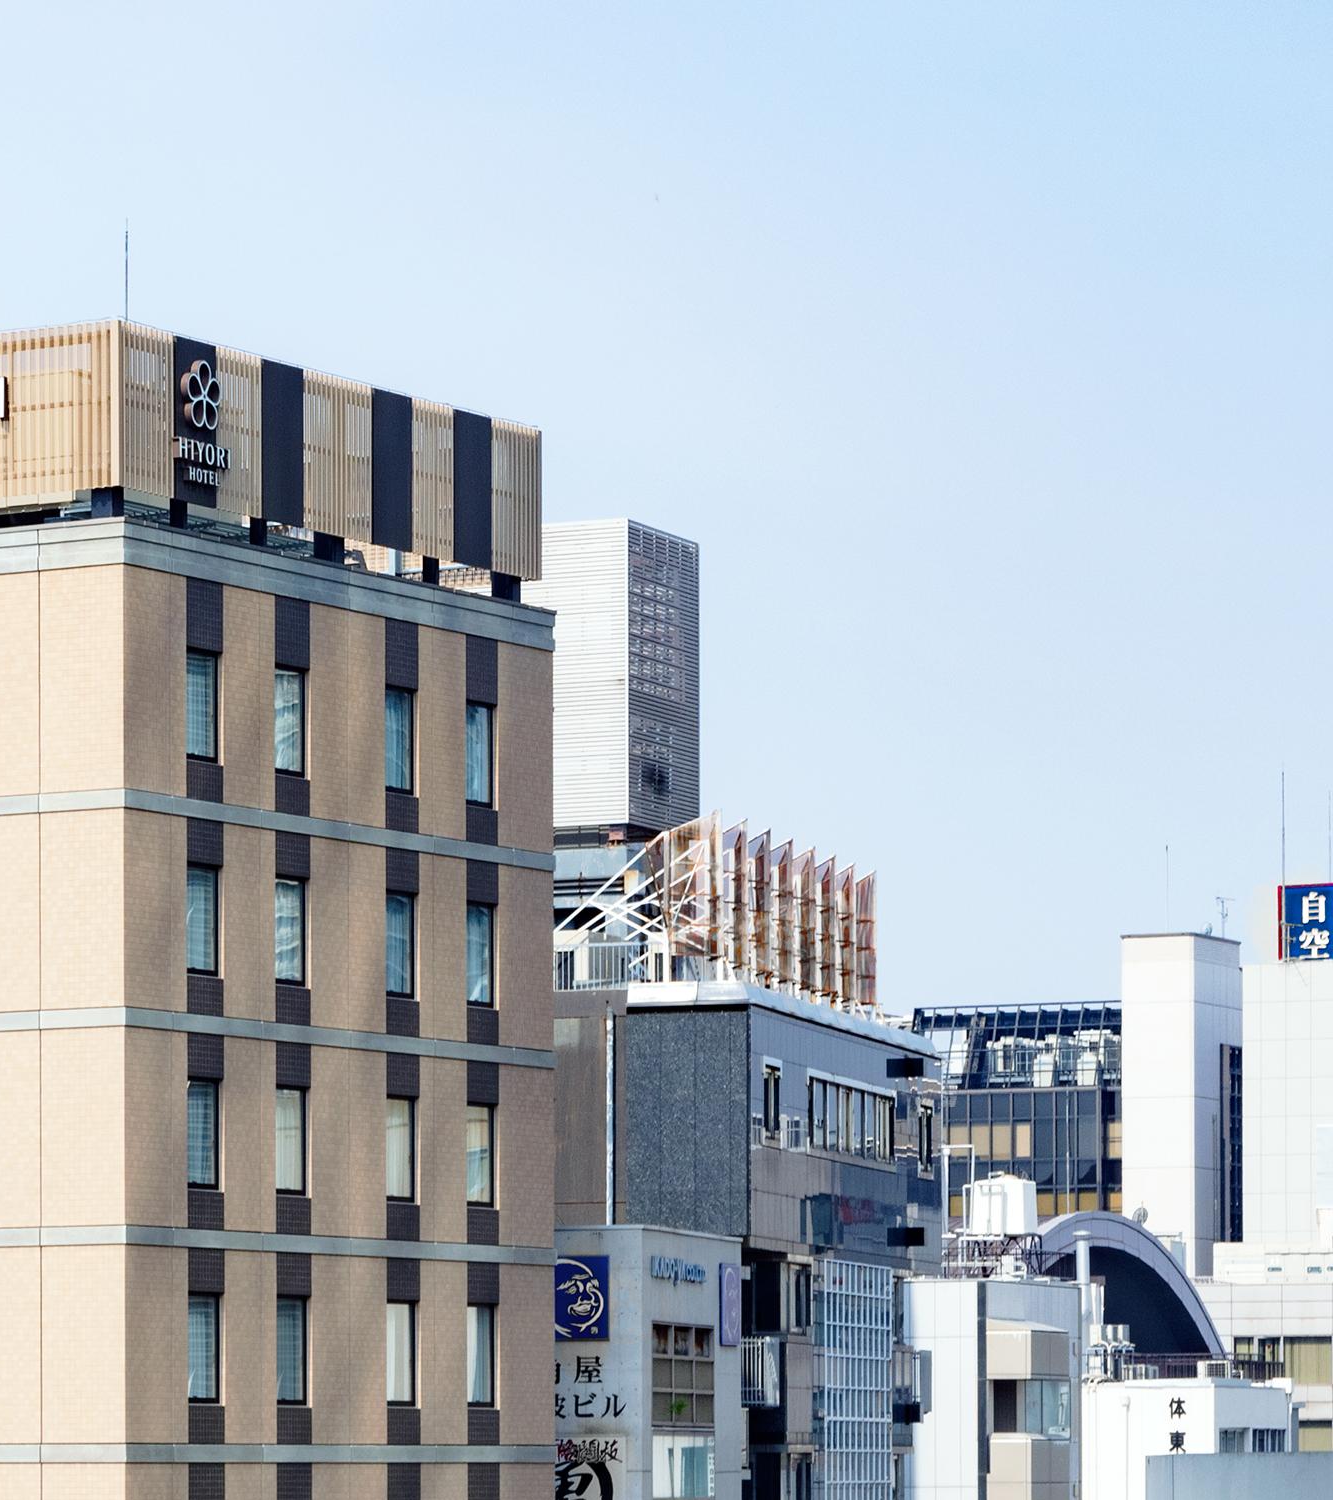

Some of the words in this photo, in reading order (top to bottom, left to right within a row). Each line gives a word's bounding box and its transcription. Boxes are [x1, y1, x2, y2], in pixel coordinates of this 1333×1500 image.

[178, 436, 231, 469] HIYORI
[189, 466, 220, 487] HOTEL
[1301, 891, 1326, 924] 自
[1299, 928, 1330, 959] 空
